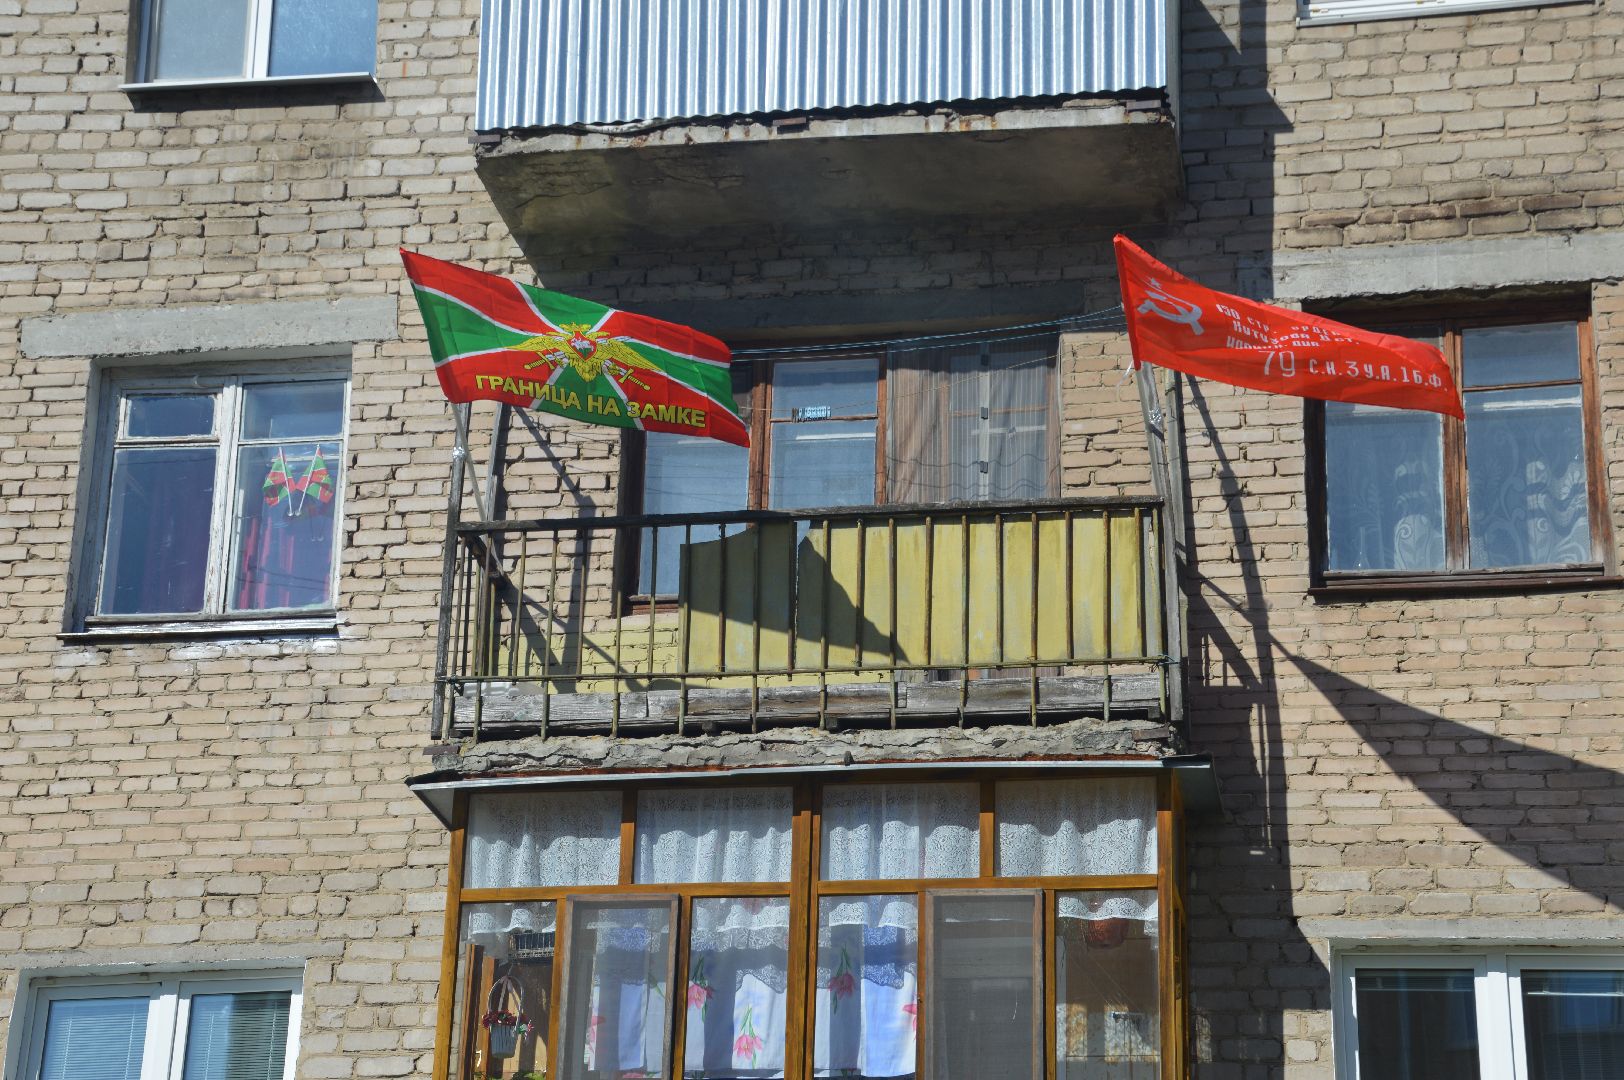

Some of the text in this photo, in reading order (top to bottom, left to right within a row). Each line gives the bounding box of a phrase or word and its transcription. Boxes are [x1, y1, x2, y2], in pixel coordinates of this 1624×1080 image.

[1258, 350, 1296, 377] 79
[475, 374, 706, 428] ГРАНИЦА НА ЗАМКЕ
